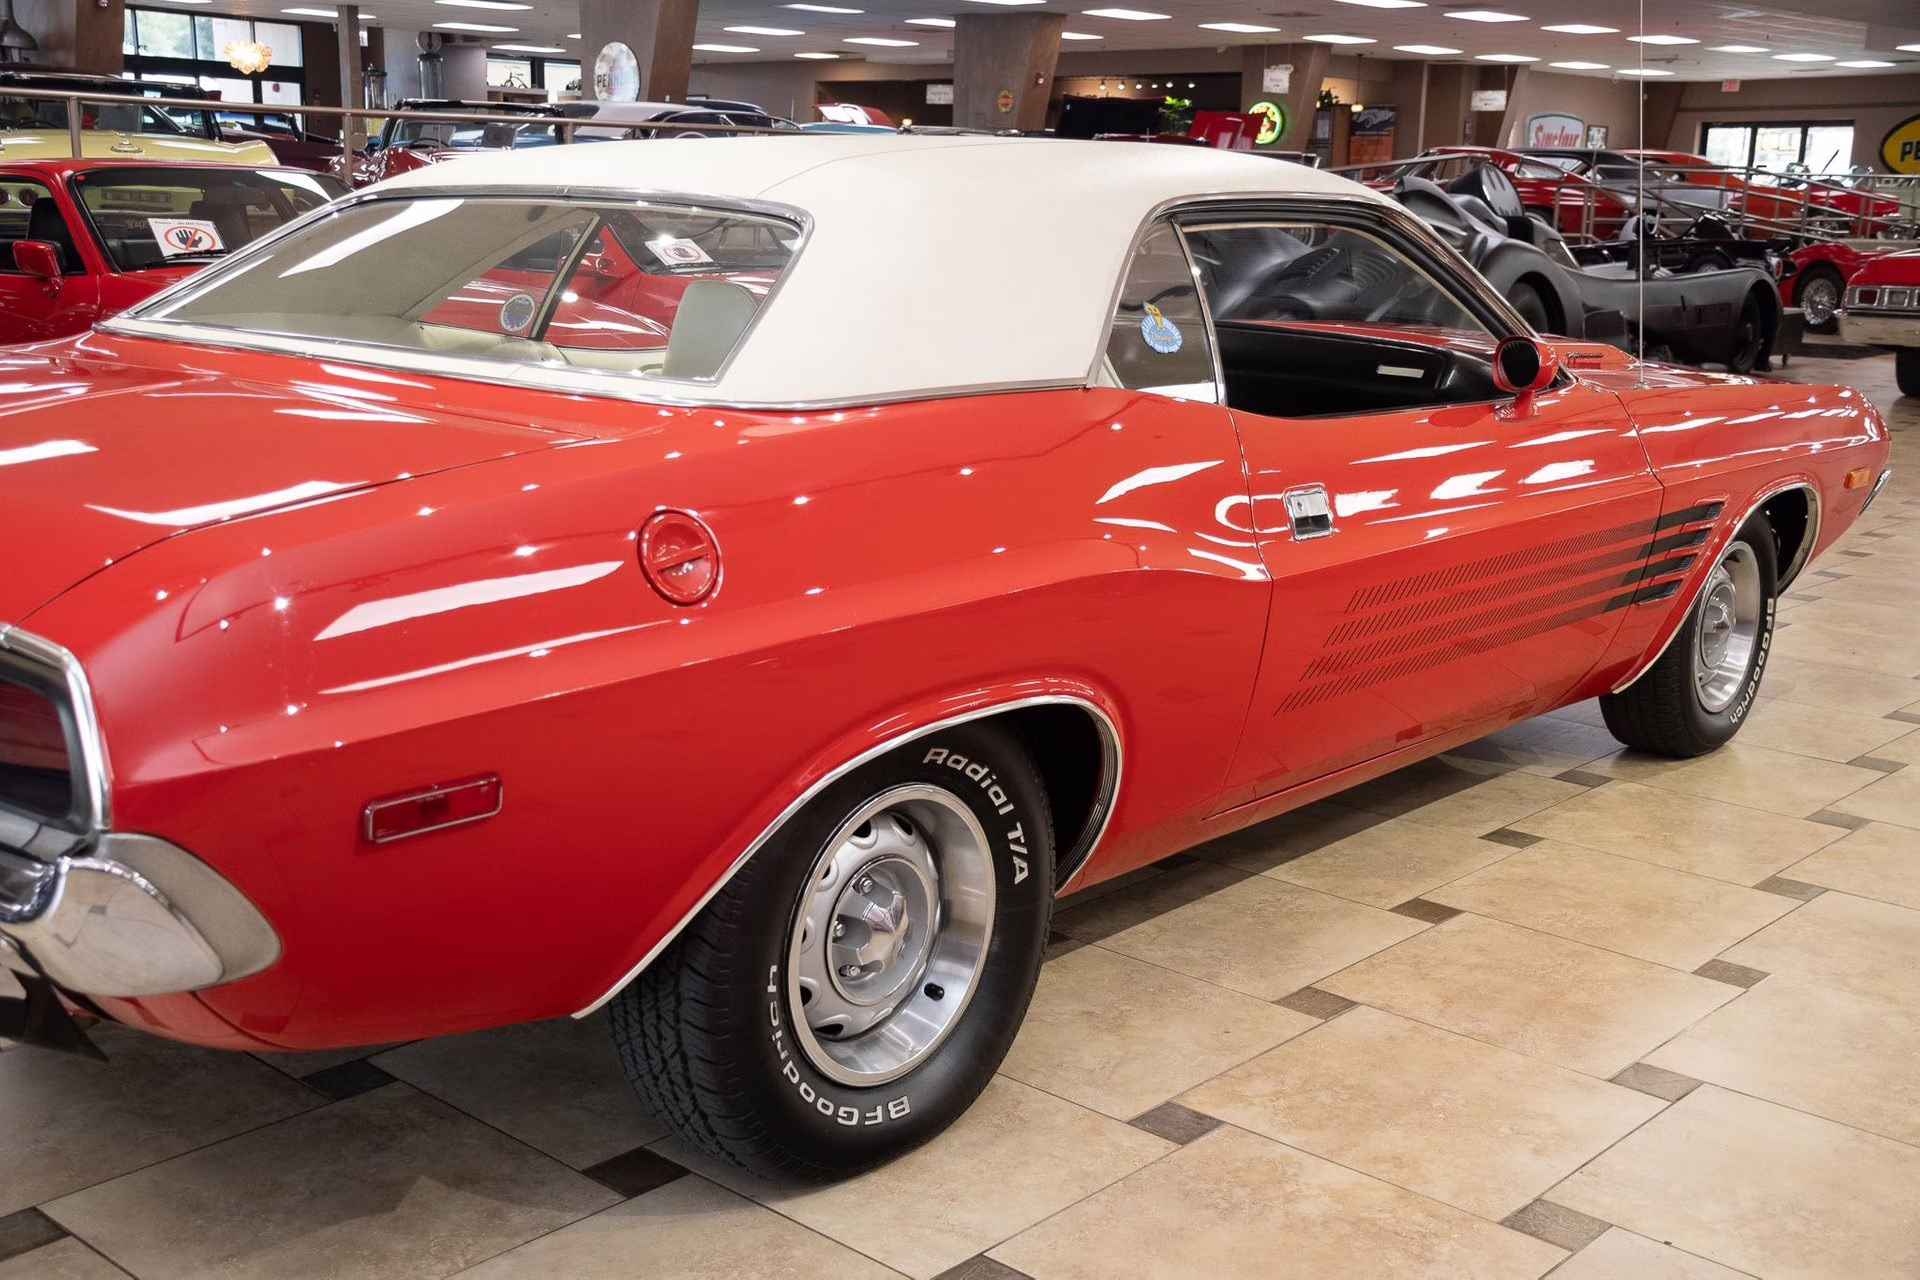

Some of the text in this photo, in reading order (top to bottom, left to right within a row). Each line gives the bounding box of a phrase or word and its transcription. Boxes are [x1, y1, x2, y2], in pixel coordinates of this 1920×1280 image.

[597, 73, 635, 88] PENNZ
[1729, 598, 1774, 725] BFGoodrich
[922, 747, 1030, 885] Radial T/A
[767, 964, 912, 1126] BFGoodrich
